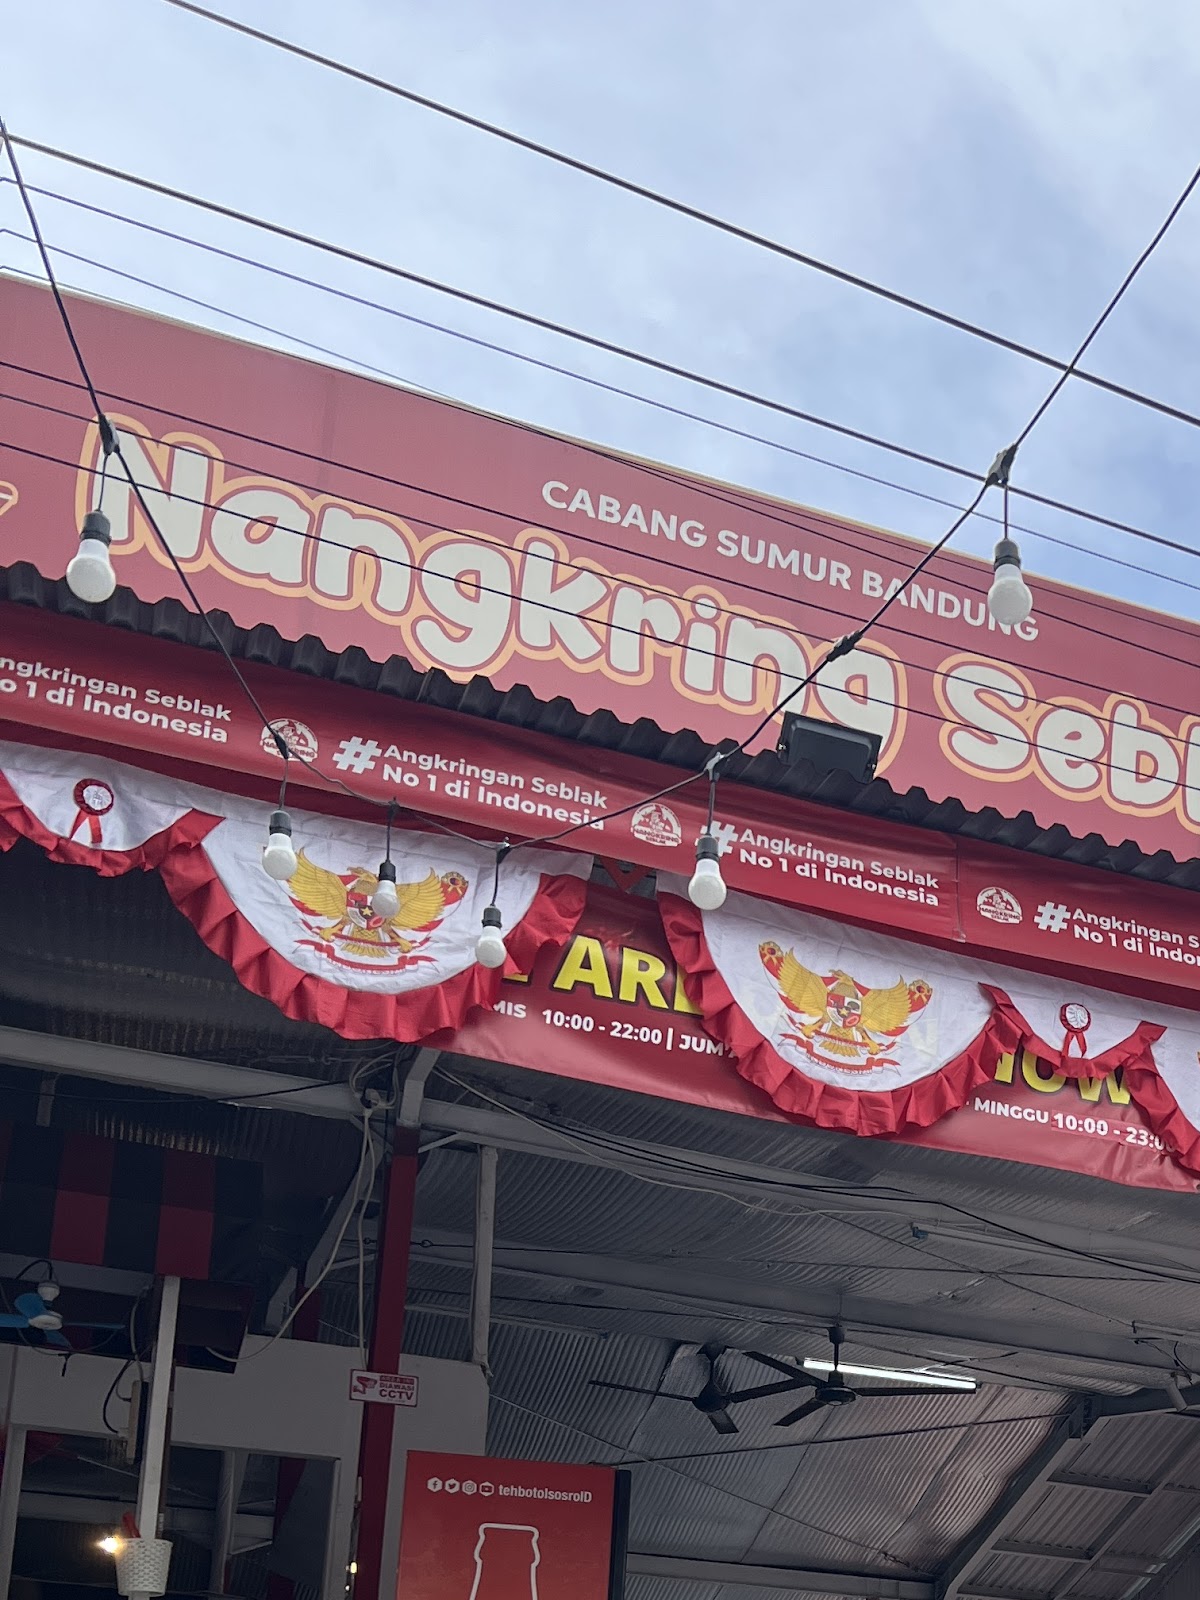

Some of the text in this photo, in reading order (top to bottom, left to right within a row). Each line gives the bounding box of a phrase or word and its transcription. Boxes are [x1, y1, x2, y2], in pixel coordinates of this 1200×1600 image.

[542, 480, 1039, 643] CABANG SUMUR BANDUNG
[90, 420, 905, 762] Nangkring
[26, 681, 37, 698] 1
[46, 686, 74, 707] di
[84, 694, 228, 744] Indonesia
[144, 689, 232, 722] Seblak
[382, 764, 605, 831] No 1 di Indonesia
[384, 744, 525, 789] Angkringan
[531, 777, 608, 809] Seblak
[739, 849, 939, 907] No 1 di Indonesia
[740, 828, 865, 872] Angkringan
[870, 856, 939, 890] Seblak
[1072, 908, 1183, 946] Angkringan
[1073, 924, 1104, 944] No
[1108, 931, 1117, 947] 1
[1123, 935, 1143, 953] di
[542, 1009, 594, 1032] 10:00
[610, 1021, 662, 1045] 22:00
[974, 1097, 1048, 1124] MINGGU
[1053, 1112, 1108, 1136] 10:00
[380, 1382, 414, 1391] DIAWASI
[380, 1389, 413, 1400] CCTV
